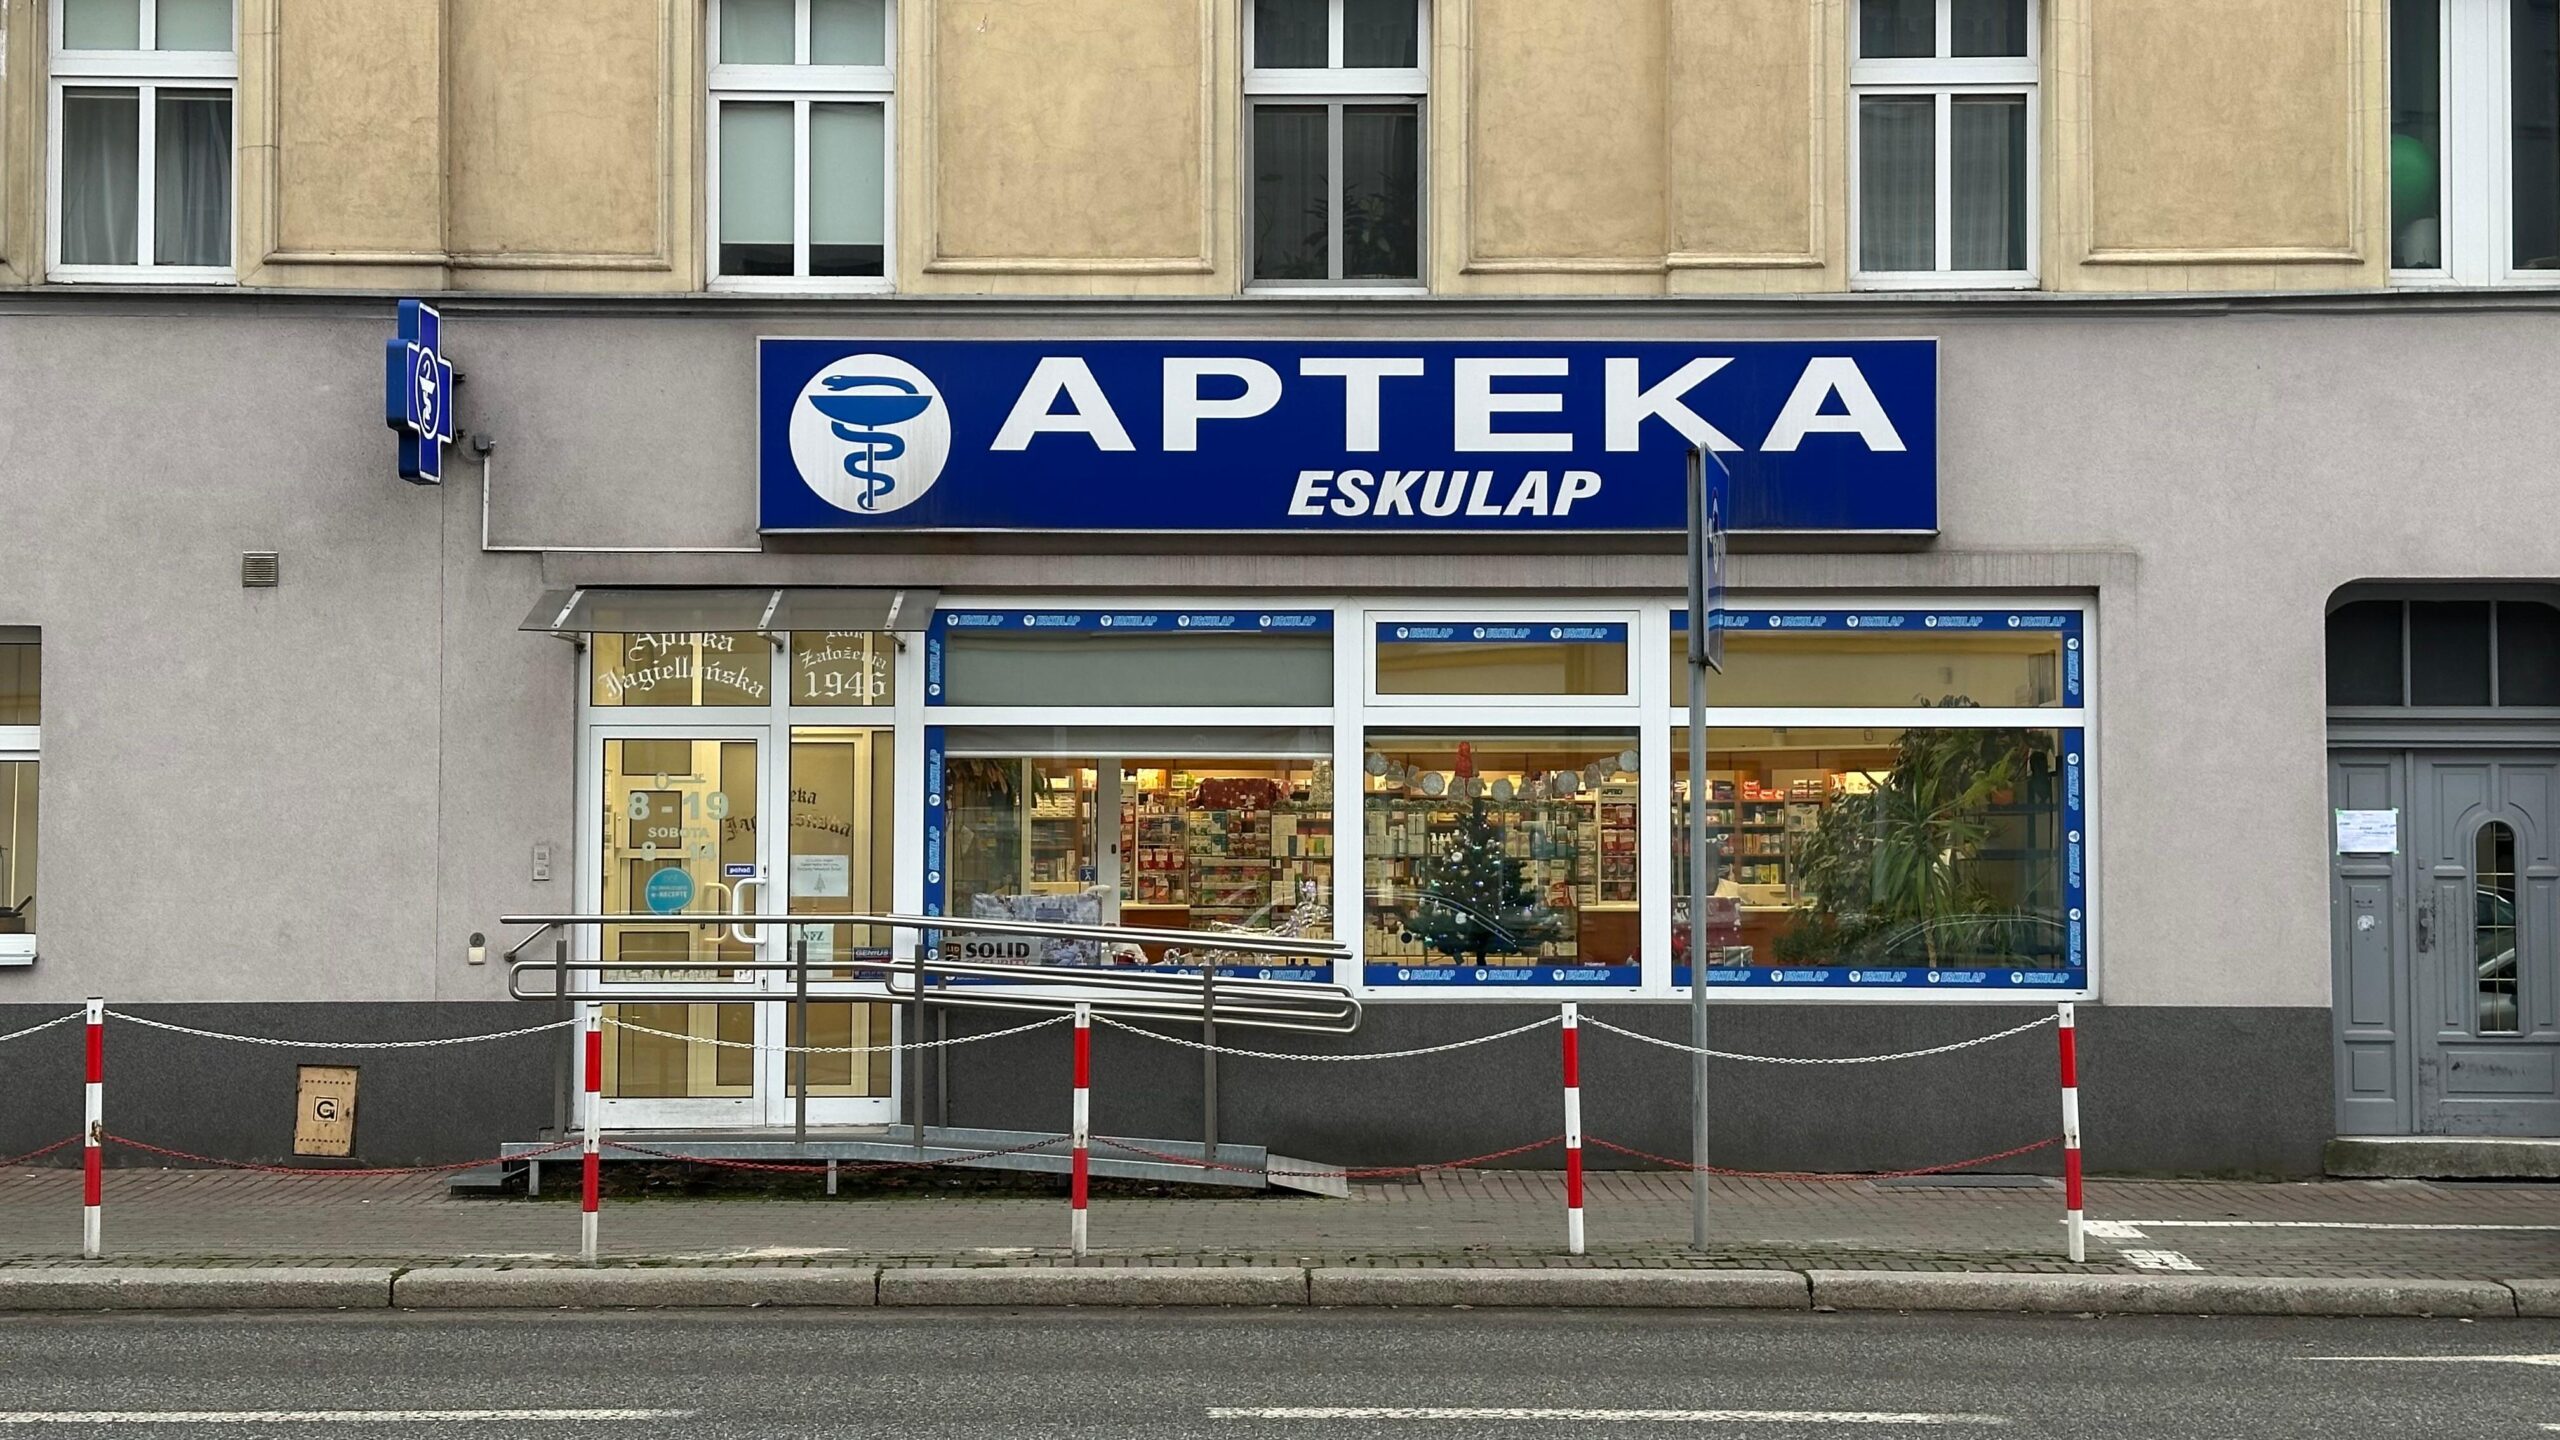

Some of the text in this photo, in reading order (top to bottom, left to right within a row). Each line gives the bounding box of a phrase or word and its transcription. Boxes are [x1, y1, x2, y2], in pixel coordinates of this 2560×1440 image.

[993, 357, 1907, 452] APTEKA
[1288, 470, 1602, 516] ESKULAP
[804, 671, 886, 697] 1946
[628, 792, 650, 820] 8
[683, 791, 729, 820] 19
[648, 827, 709, 838] SOBOTA
[640, 841, 657, 861] 8
[966, 943, 1030, 958] SOLID
[317, 1101, 336, 1119] G
